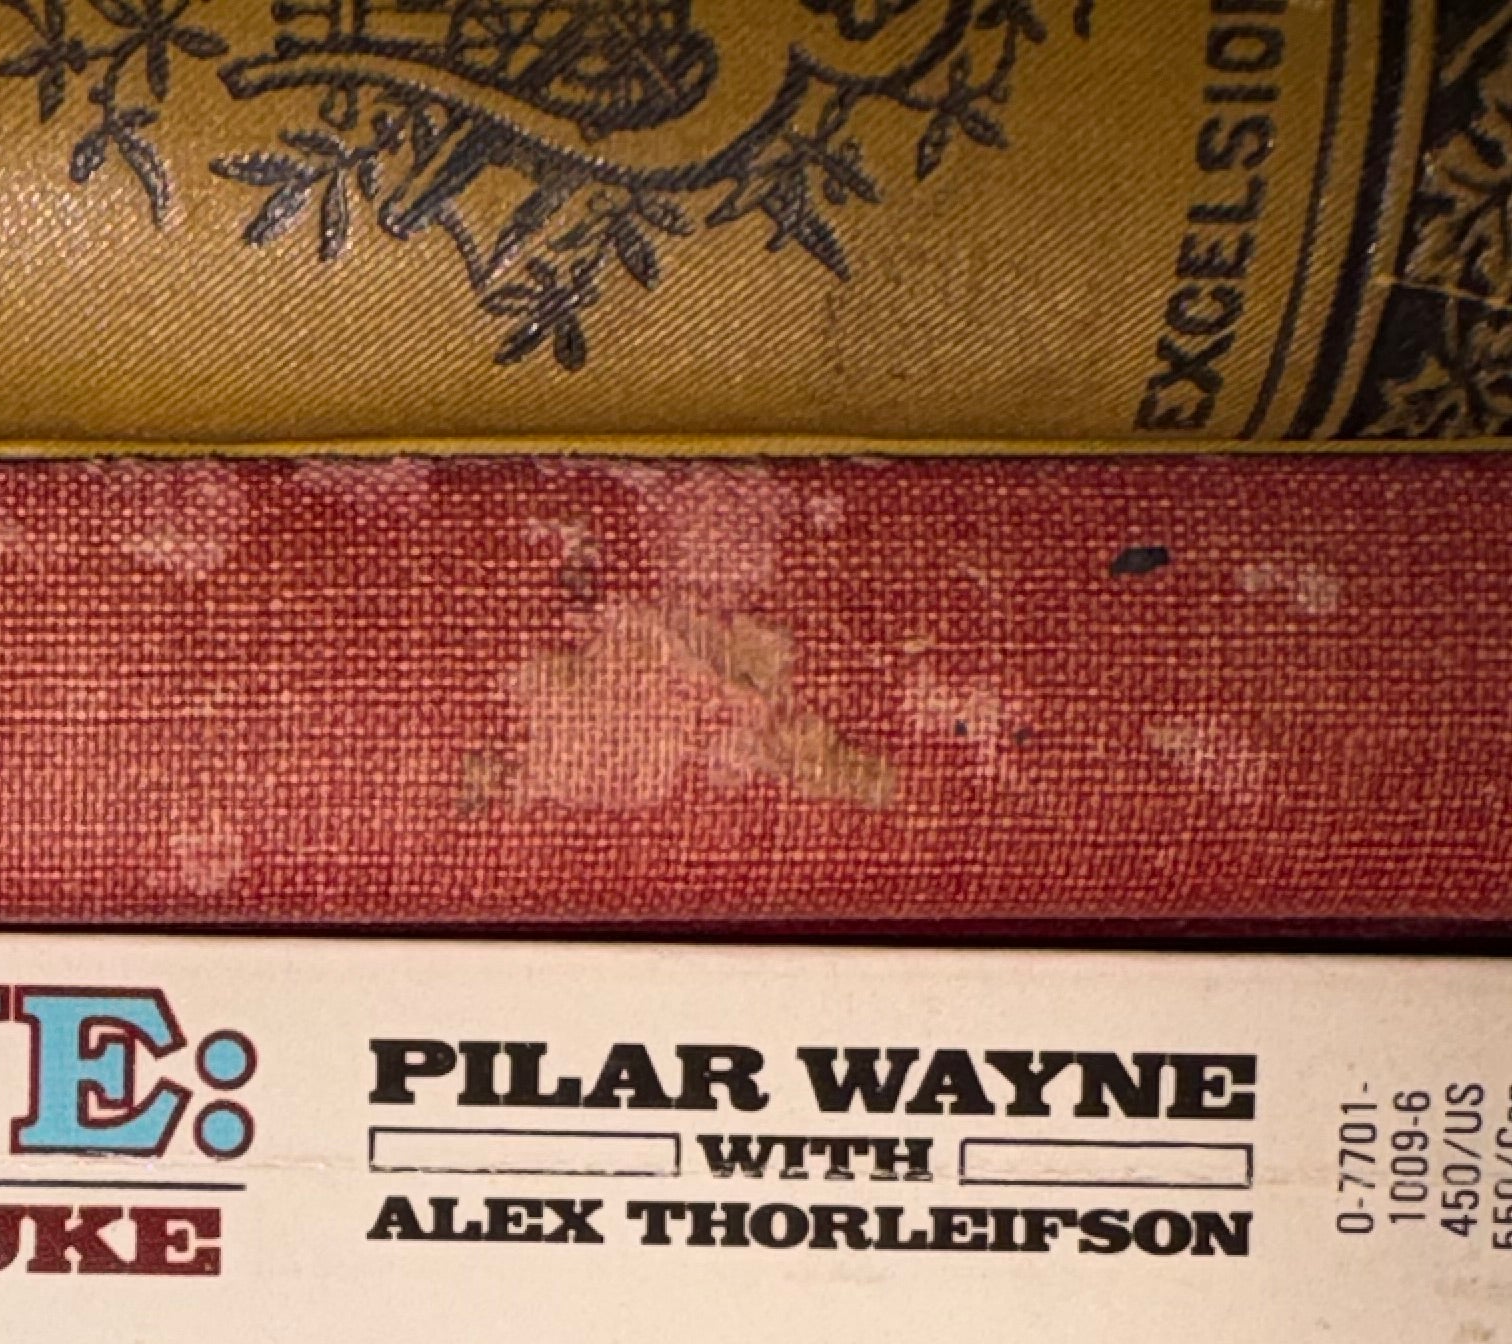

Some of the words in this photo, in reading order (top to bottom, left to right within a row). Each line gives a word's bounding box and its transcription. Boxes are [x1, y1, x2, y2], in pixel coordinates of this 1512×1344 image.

[1133, 0, 1288, 430] EXCELSIO
[368, 1039, 768, 1110] PILAR
[797, 1046, 1257, 1119] WAYNE
[697, 1134, 933, 1181] WITH
[1337, 1081, 1377, 1233] 0-7701-
[1389, 1090, 1431, 1223] 1009-6
[1440, 1083, 1484, 1237] 450/US
[367, 1196, 603, 1242] ALEX
[627, 1200, 1252, 1255] THORLEIFSON
